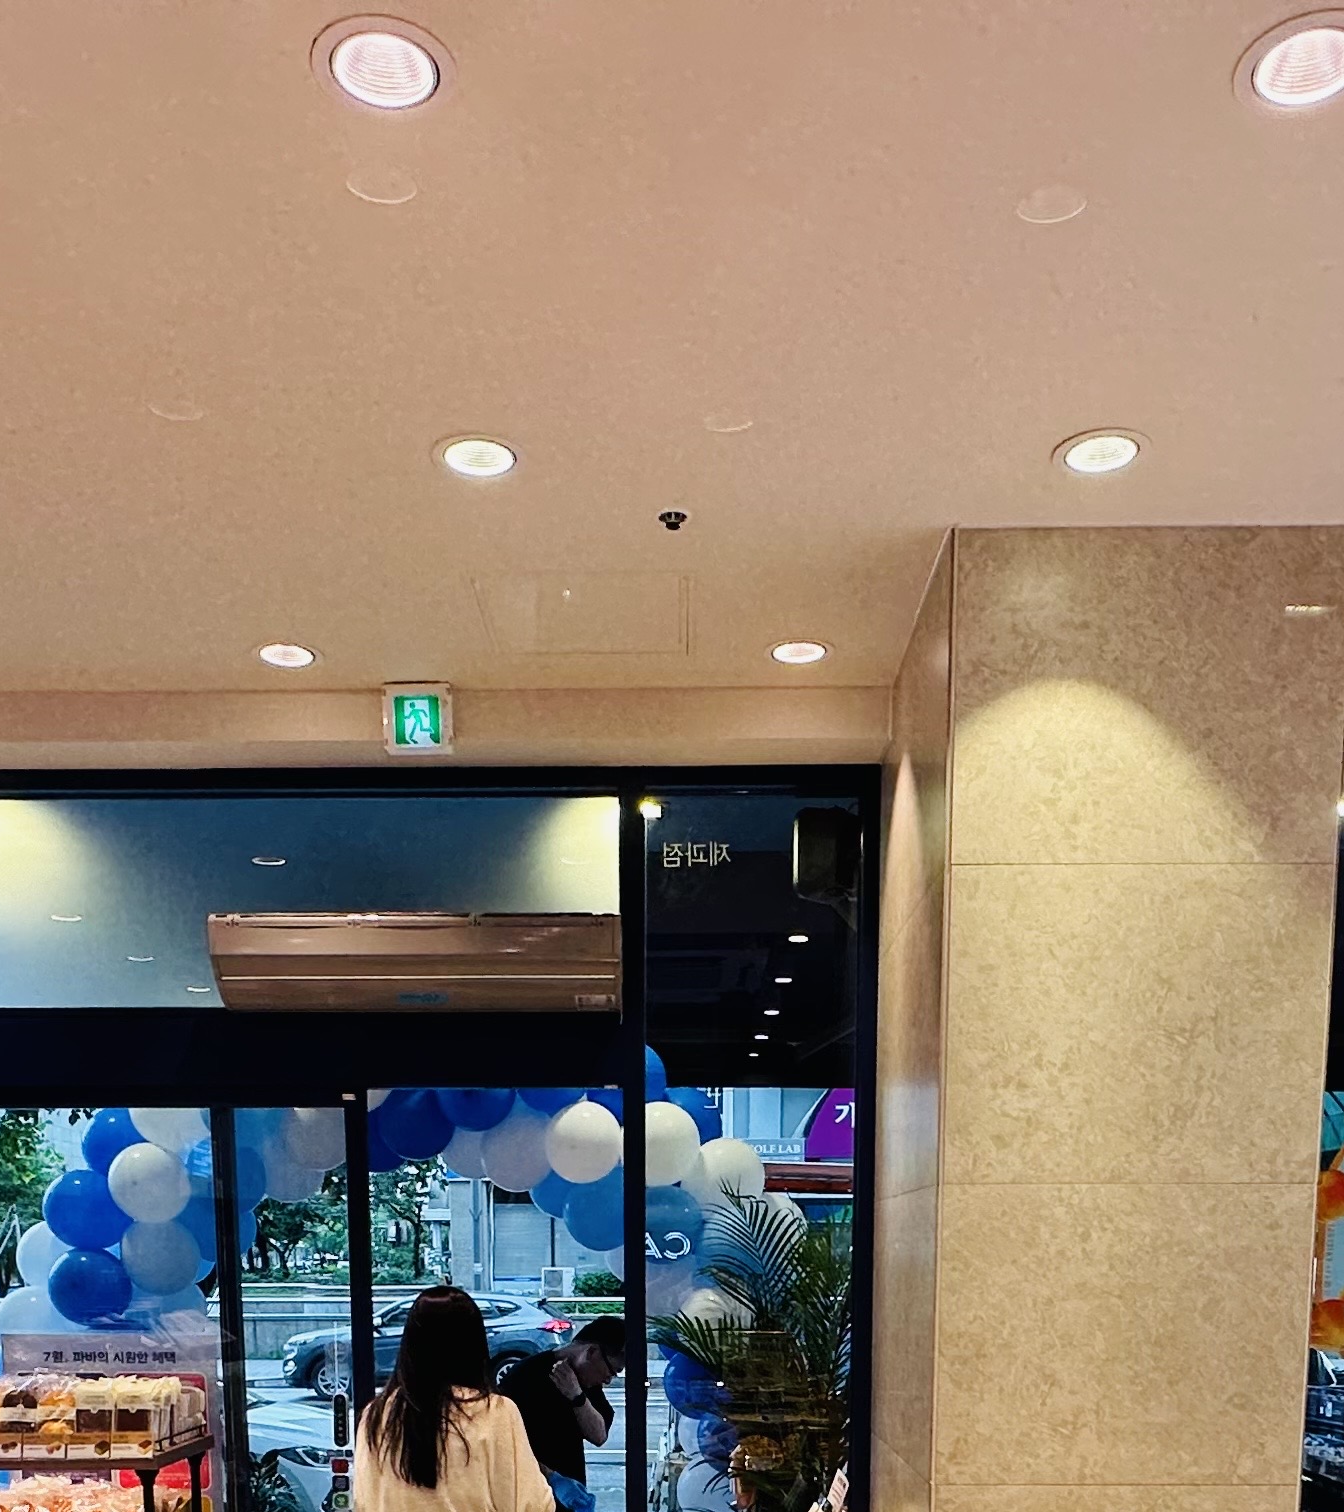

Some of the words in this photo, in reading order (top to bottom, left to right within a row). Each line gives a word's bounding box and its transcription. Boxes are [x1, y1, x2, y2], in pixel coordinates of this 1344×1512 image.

[778, 1144, 801, 1154] LAB
[72, 1350, 109, 1364] 파바의
[113, 1350, 149, 1364] 시원한
